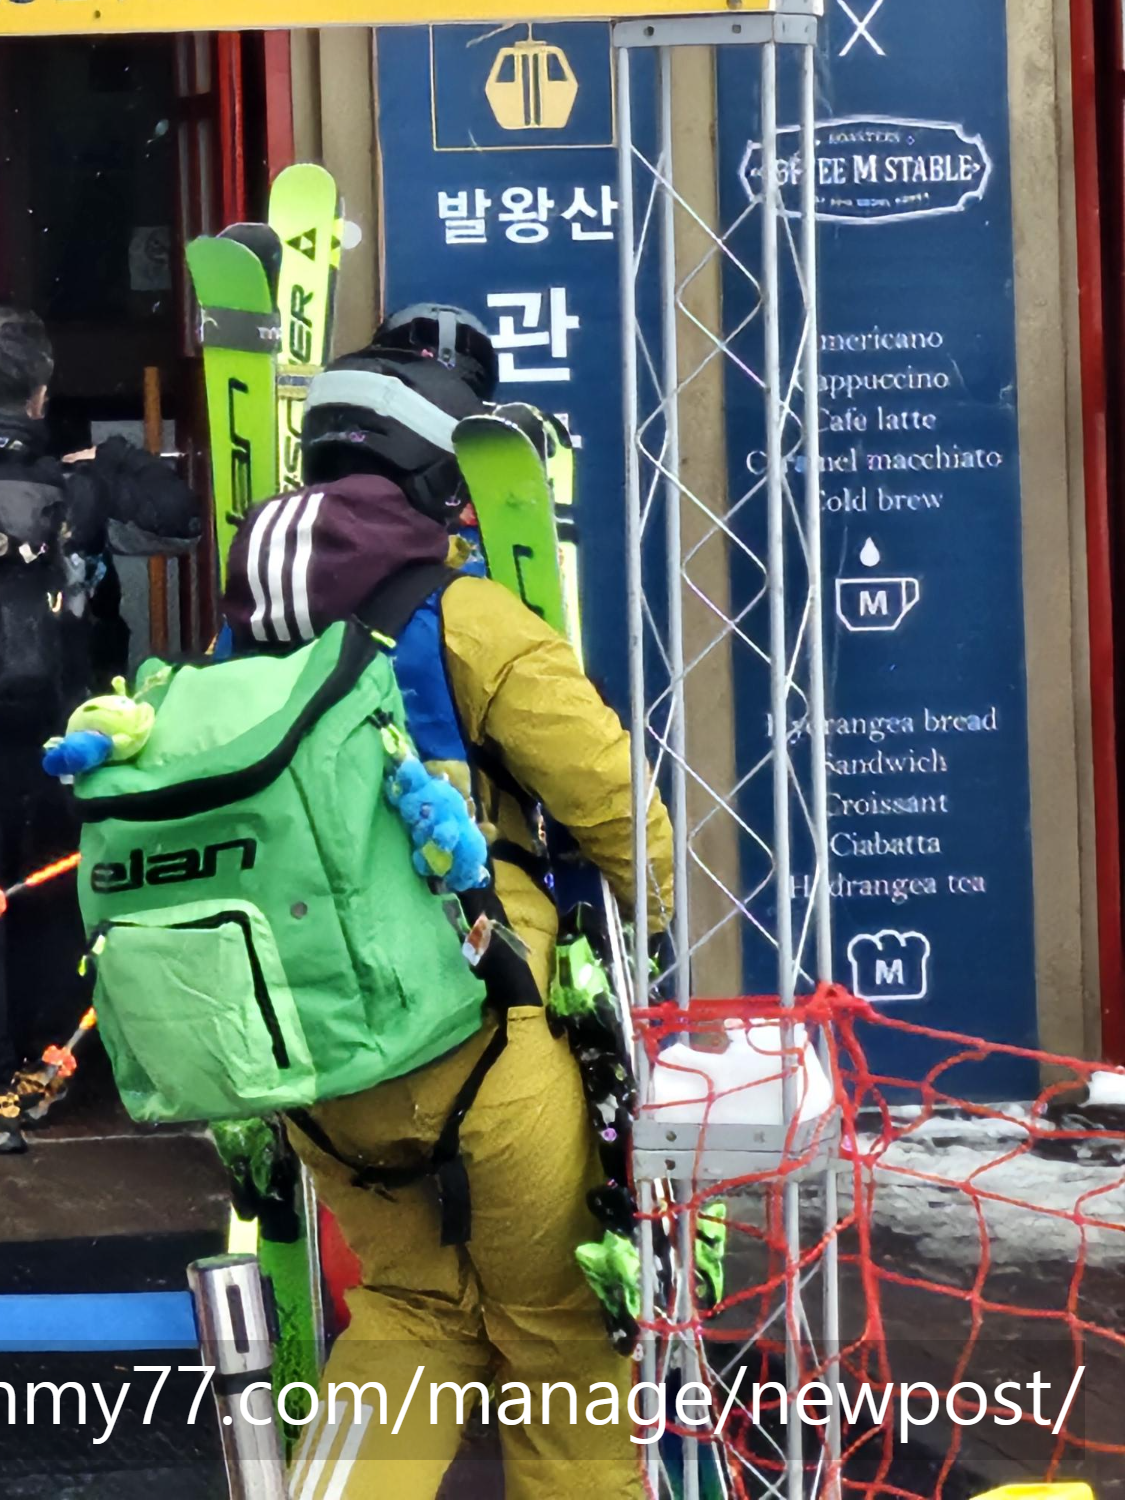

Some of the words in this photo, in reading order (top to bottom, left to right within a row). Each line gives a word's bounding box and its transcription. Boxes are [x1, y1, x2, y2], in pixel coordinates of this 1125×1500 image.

[853, 154, 878, 184] M
[884, 154, 973, 183] STABLE
[437, 185, 619, 244] 발왕산
[819, 325, 943, 350] mericano
[878, 406, 937, 431] latte
[868, 445, 1003, 473] macchiato
[820, 487, 868, 512] old
[878, 486, 943, 512] brew
[860, 590, 888, 616] M
[924, 706, 998, 732] bread
[829, 832, 941, 857] Ciabatta
[91, 837, 257, 893] elan
[789, 872, 937, 905] Hdrangea
[948, 874, 987, 894] tea
[875, 958, 904, 986] M
